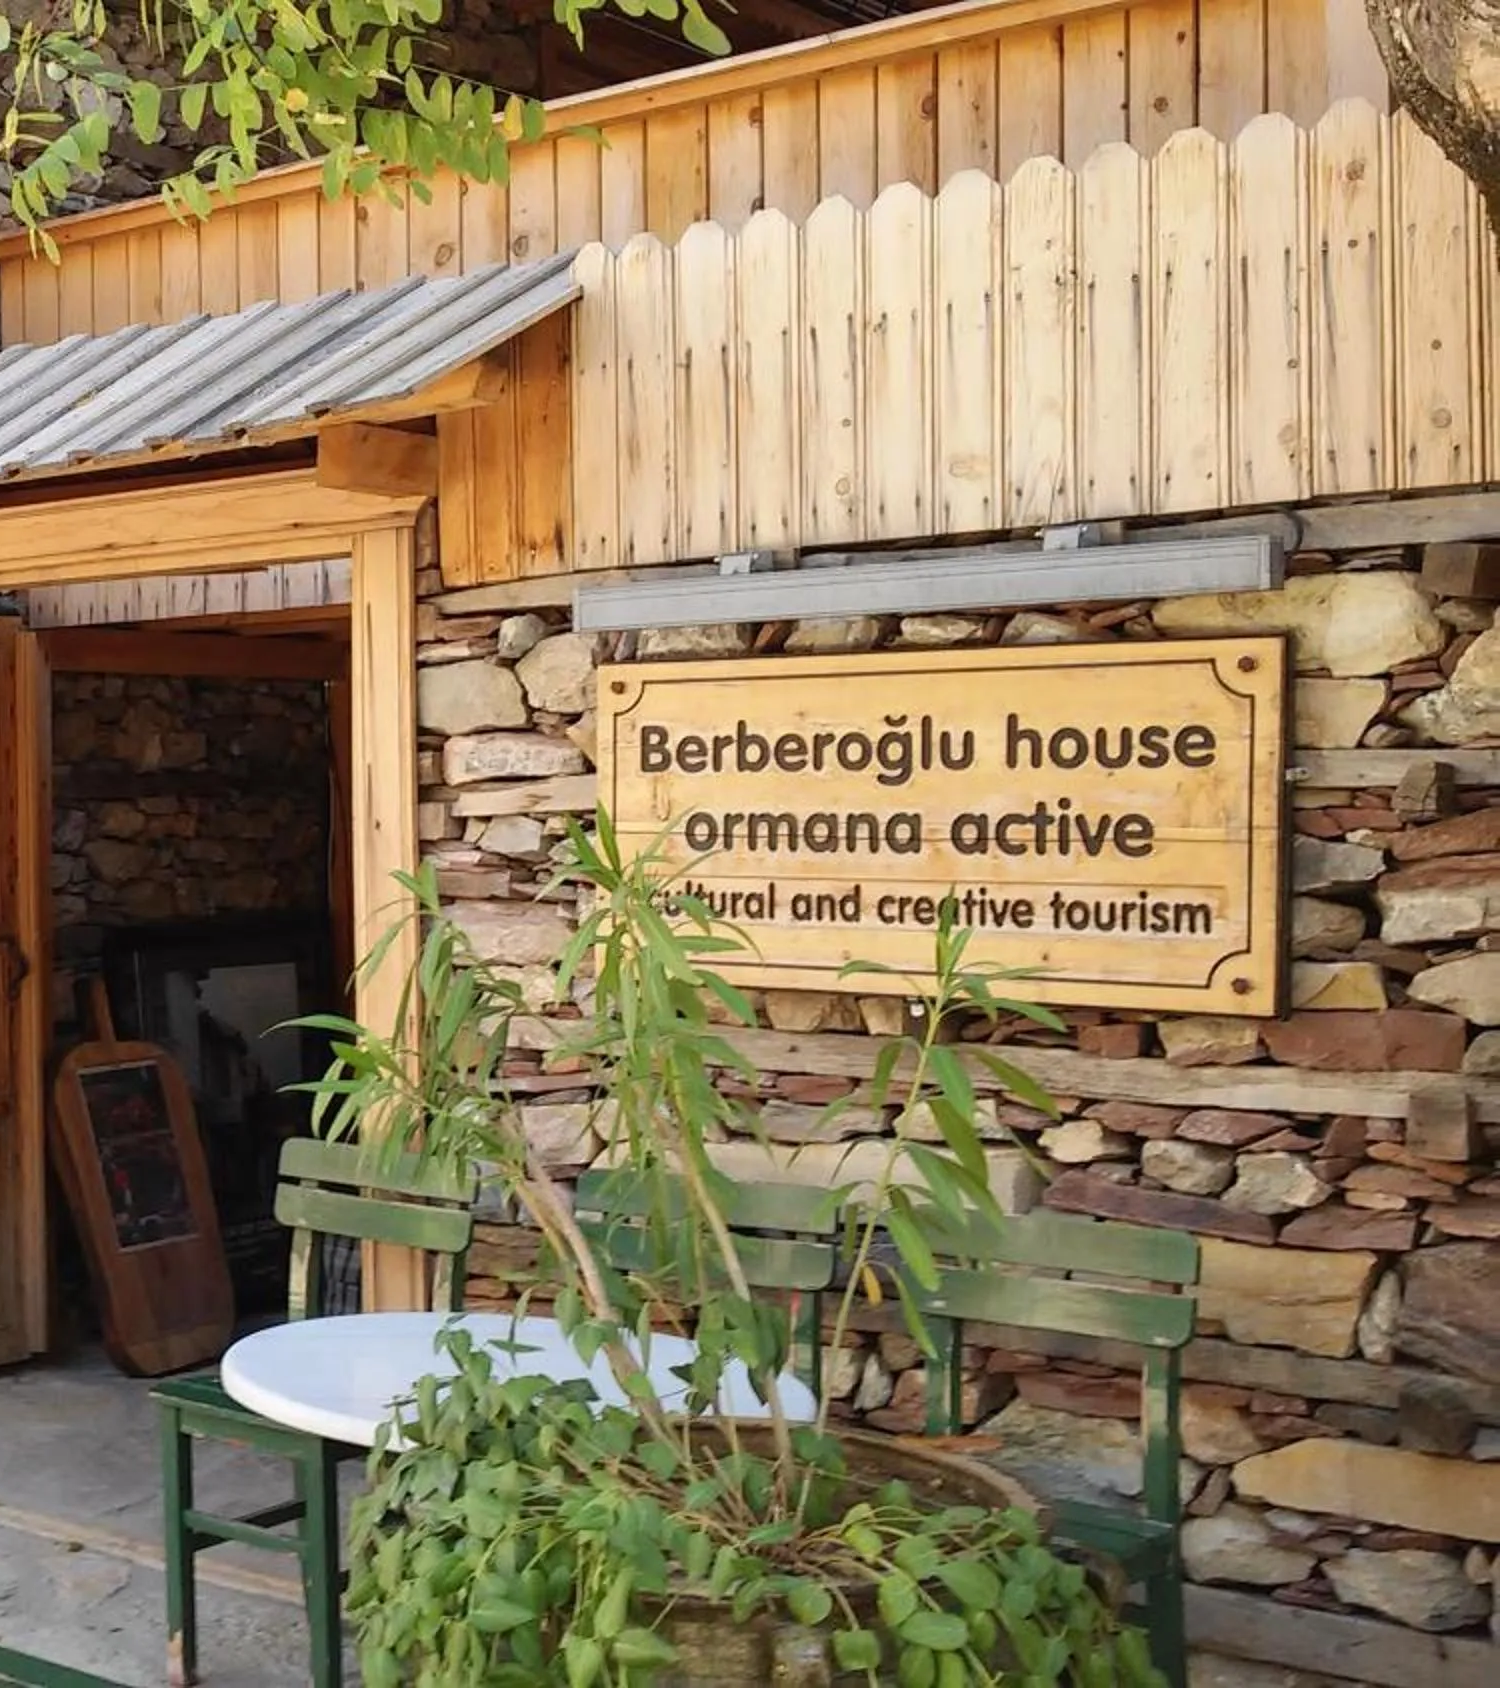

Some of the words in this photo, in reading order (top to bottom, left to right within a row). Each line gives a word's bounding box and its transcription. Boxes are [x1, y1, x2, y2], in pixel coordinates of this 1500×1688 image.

[639, 714, 975, 787] Berberoğlu
[1005, 713, 1217, 770] house
[683, 811, 922, 854] ormana
[949, 797, 1155, 858] active
[790, 884, 862, 923] and
[1049, 890, 1212, 935] tourism
